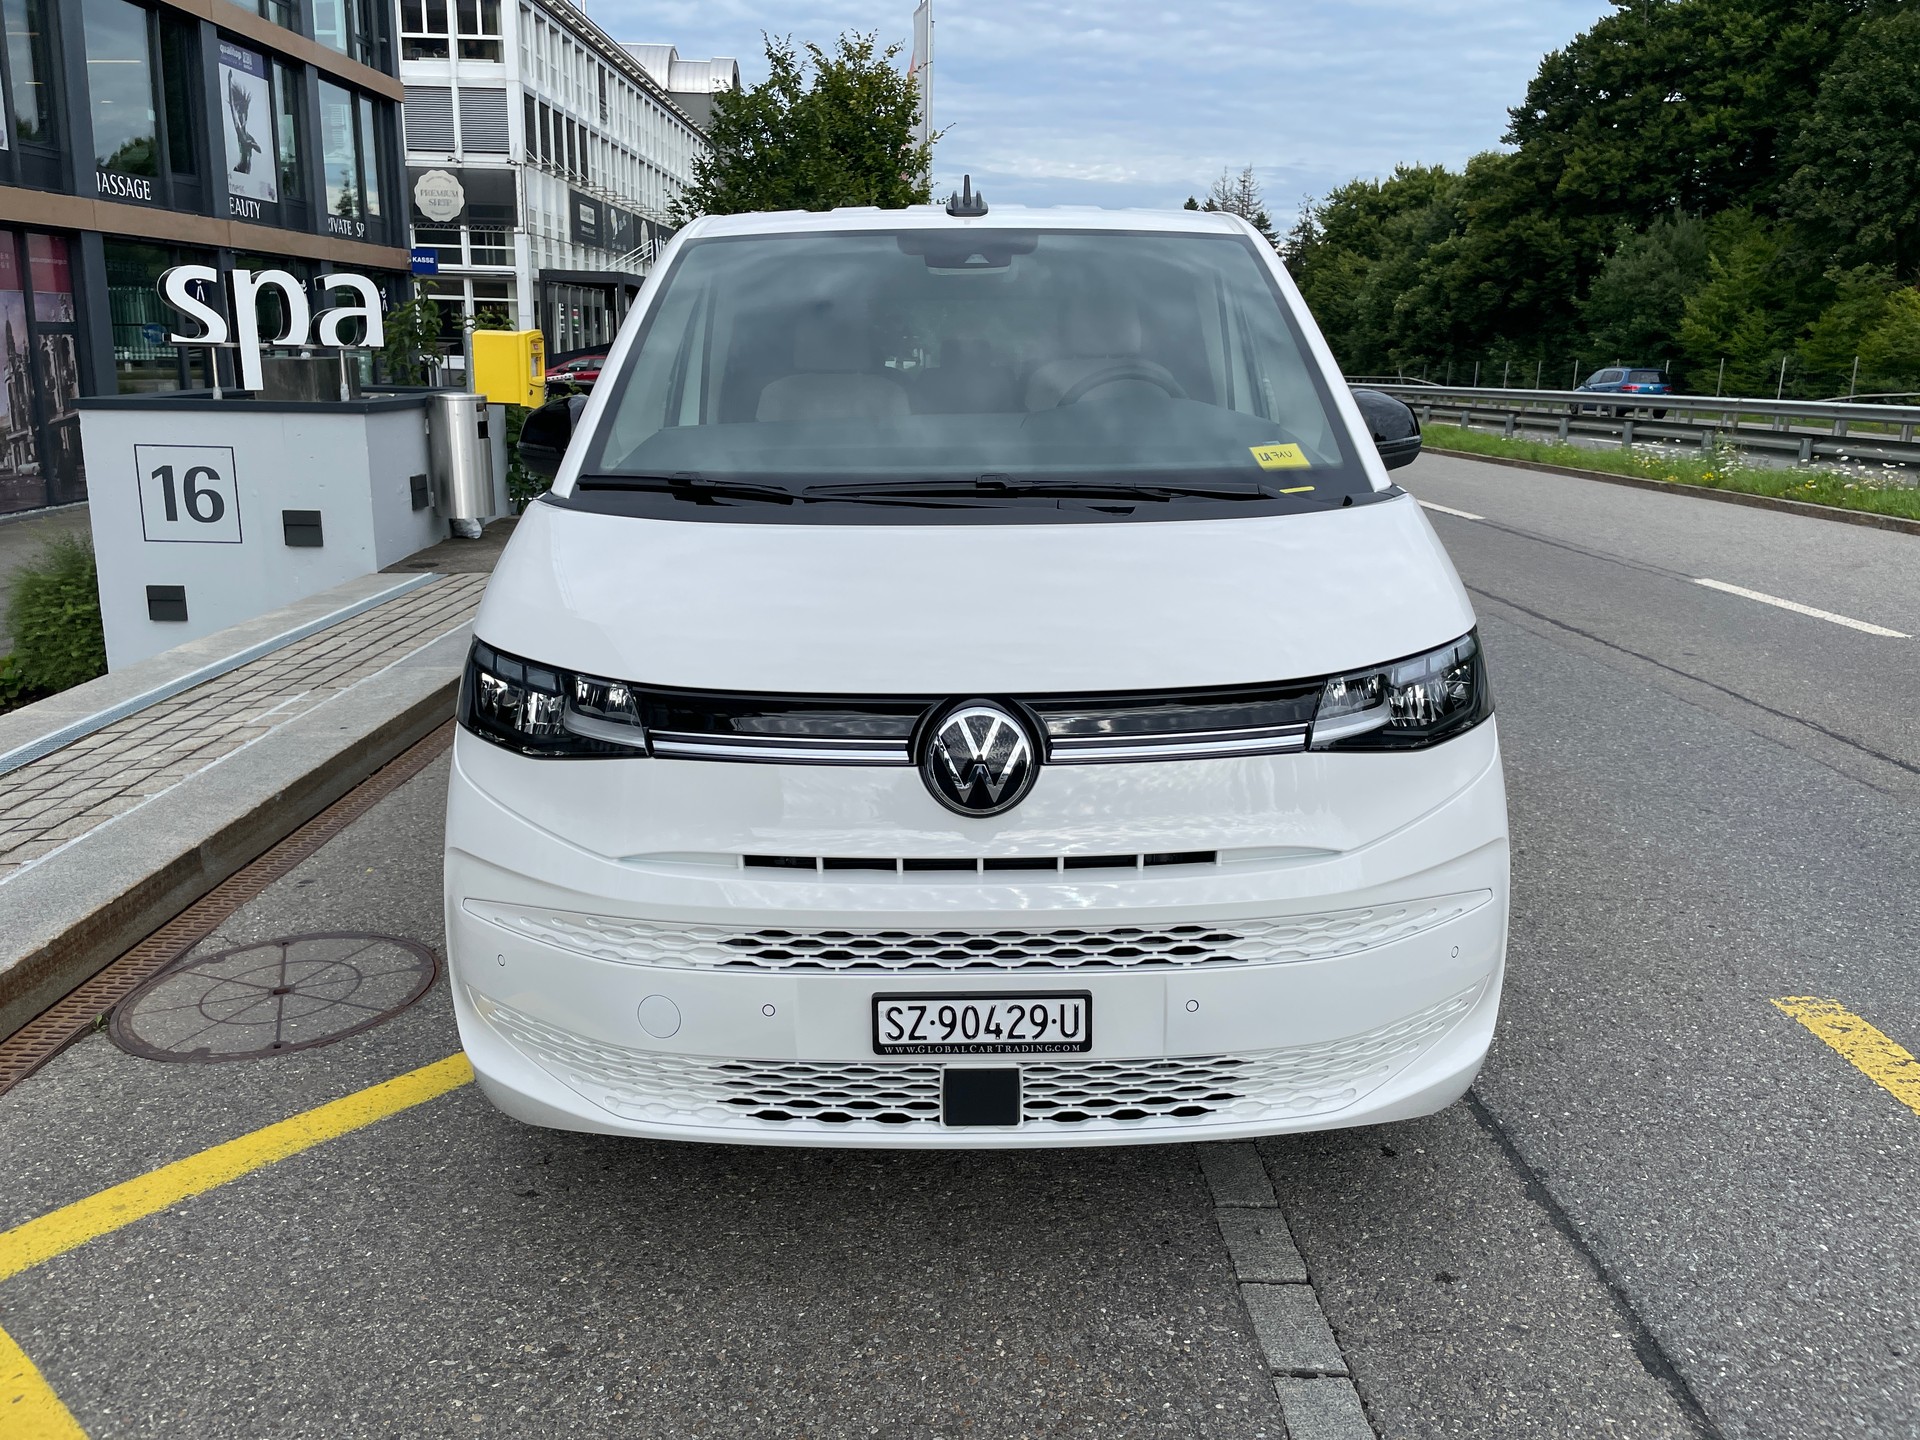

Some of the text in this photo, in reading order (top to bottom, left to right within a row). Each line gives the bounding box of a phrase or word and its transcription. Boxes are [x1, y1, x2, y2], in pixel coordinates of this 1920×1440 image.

[412, 256, 435, 264] KASSE
[157, 265, 385, 391] spa
[151, 465, 225, 523] 16
